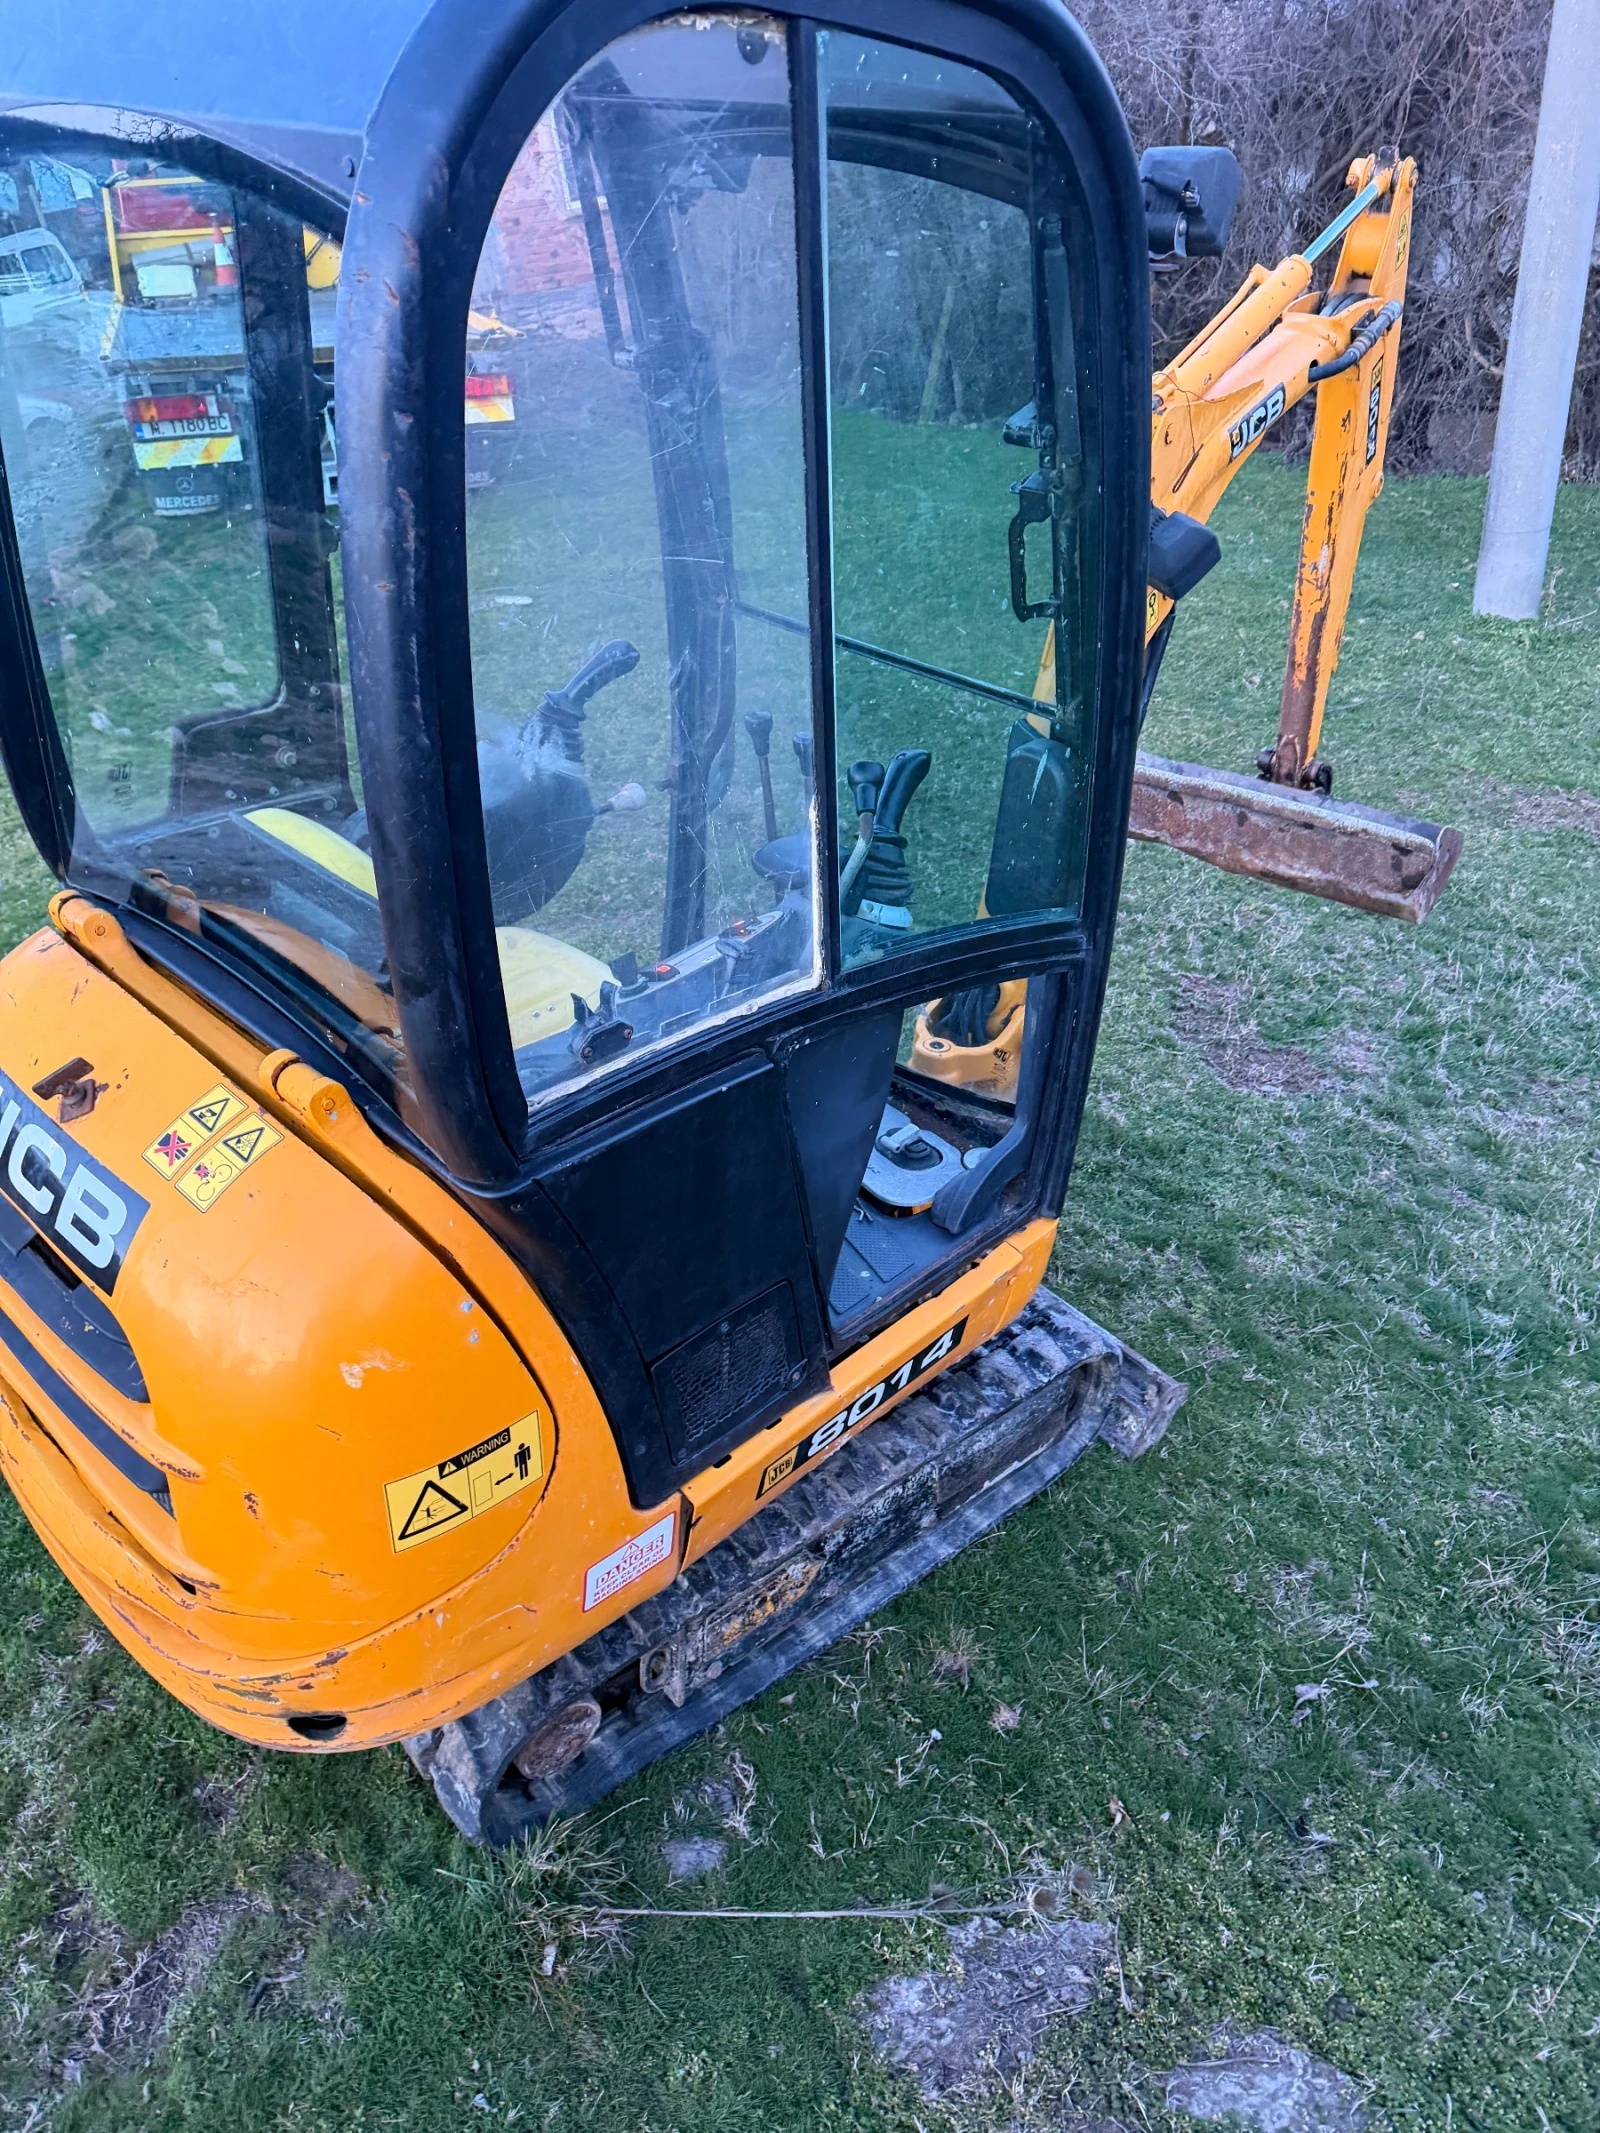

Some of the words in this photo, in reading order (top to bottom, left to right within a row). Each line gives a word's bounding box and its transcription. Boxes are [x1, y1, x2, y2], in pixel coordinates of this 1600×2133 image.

[207, 415, 229, 431] BC
[1232, 389, 1285, 459] JCB
[155, 494, 220, 508] MERCEDES
[770, 1458, 793, 1483] JCB
[807, 1328, 954, 1457] 8014
[460, 1432, 509, 1466] WARNING
[593, 1578, 618, 1598] KEEP
[621, 1556, 650, 1579] CLEAR
[593, 1575, 634, 1603] MACHINE
[636, 1553, 664, 1575] SWING
[597, 1535, 664, 1587] DANGER
